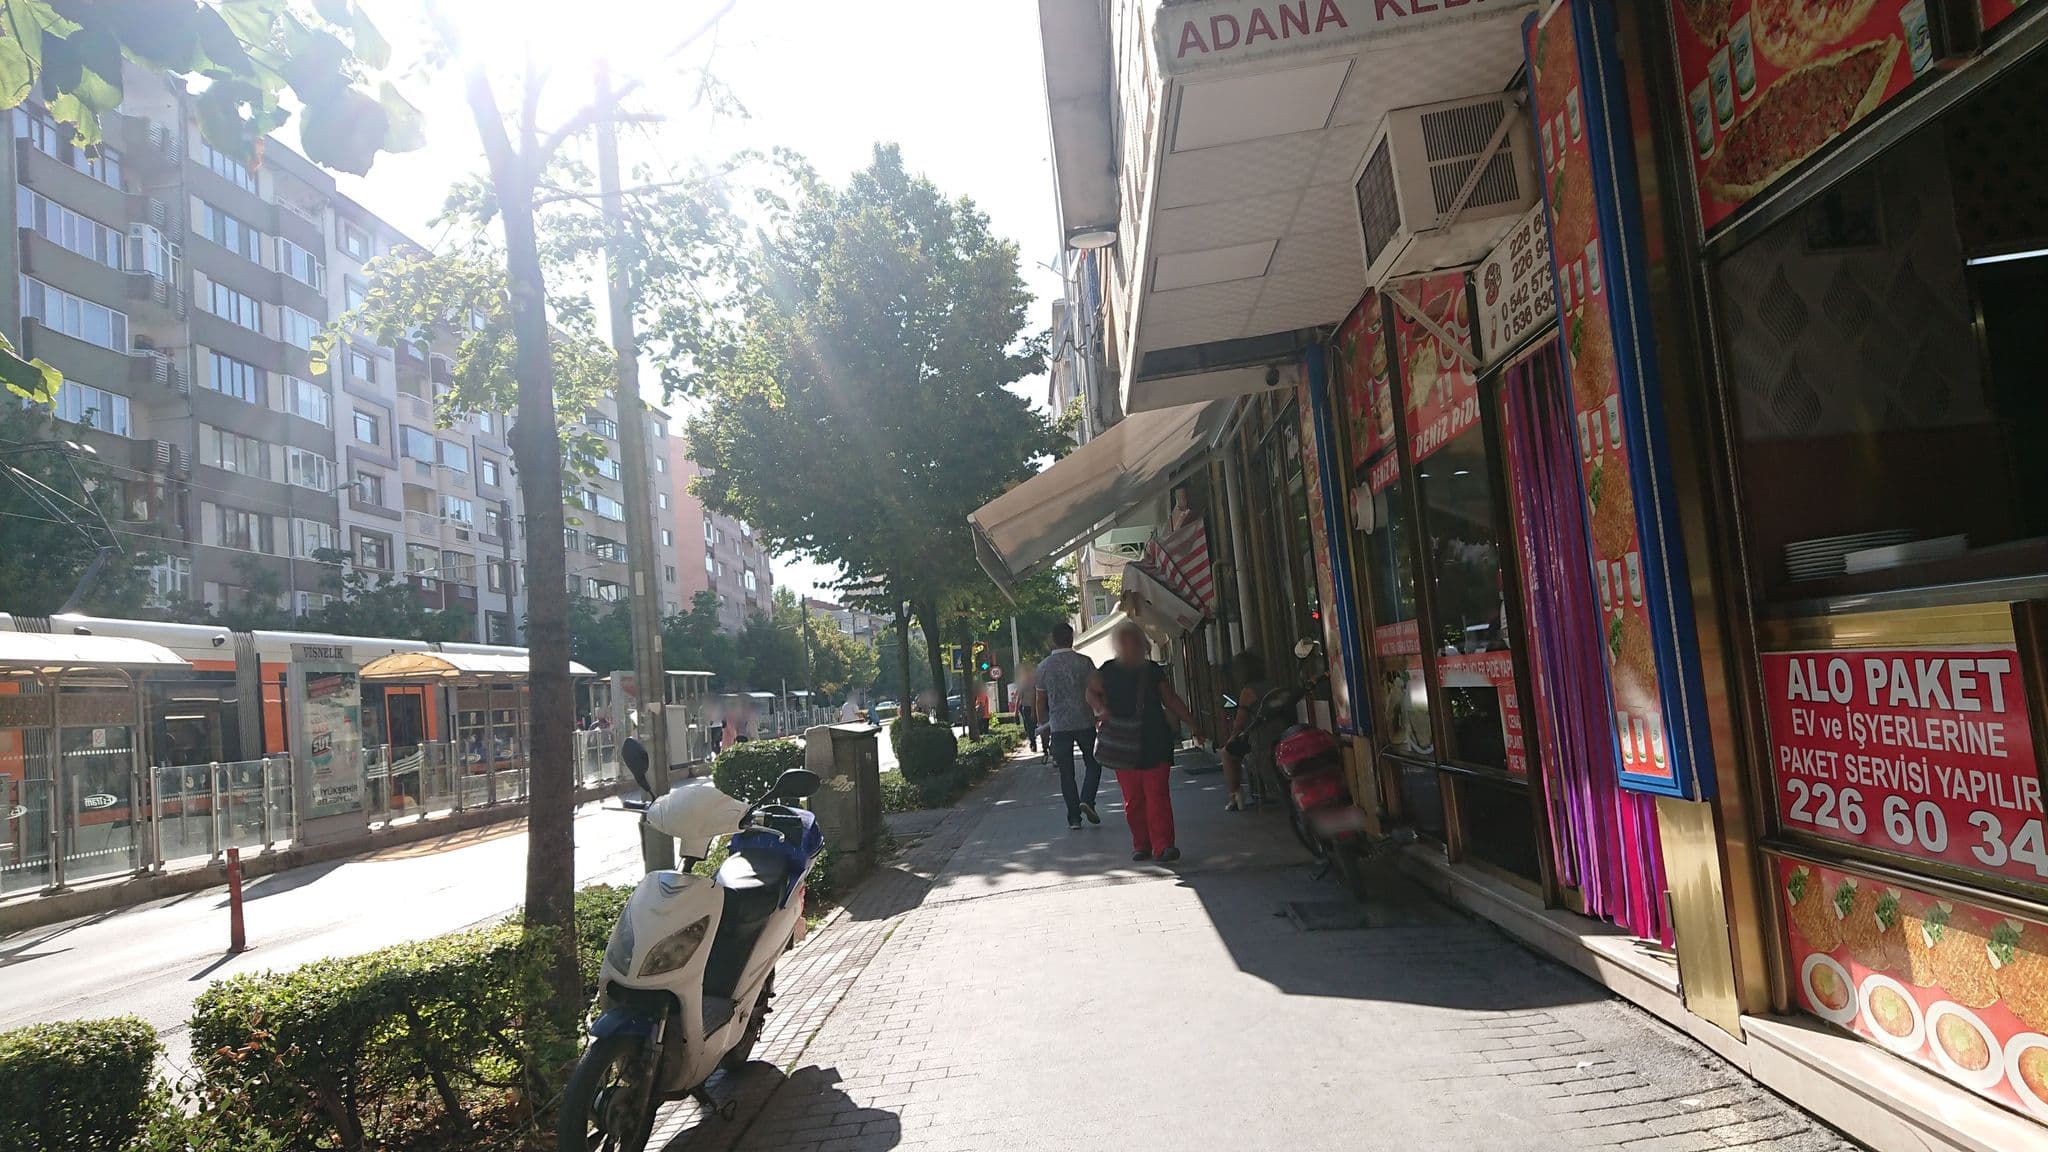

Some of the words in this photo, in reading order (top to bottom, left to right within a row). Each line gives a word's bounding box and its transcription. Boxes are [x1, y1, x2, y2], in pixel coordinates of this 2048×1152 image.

[1177, 0, 1348, 58] ADANA
[1510, 225, 1531, 261] 226
[1512, 248, 1533, 284] 226
[1501, 302, 1509, 321] 0
[1510, 282, 1530, 314] 542
[1531, 260, 1553, 294] 573
[1503, 323, 1511, 342] 0
[1512, 305, 1533, 335] 536
[1535, 285, 1556, 317] 630
[1787, 657, 1854, 705] ALO
[1863, 658, 2011, 713] PAKET
[1791, 708, 1815, 737] EV
[1820, 716, 1843, 740] ve
[1846, 706, 2008, 758] İŞYERLERİNE
[1780, 745, 1839, 780] PAKET
[1844, 753, 1932, 795] SERVİSİ
[1934, 765, 2045, 814] YAPILIR
[1786, 778, 1868, 835] 226
[1882, 795, 1949, 853] 60
[1967, 810, 2048, 879] 34
